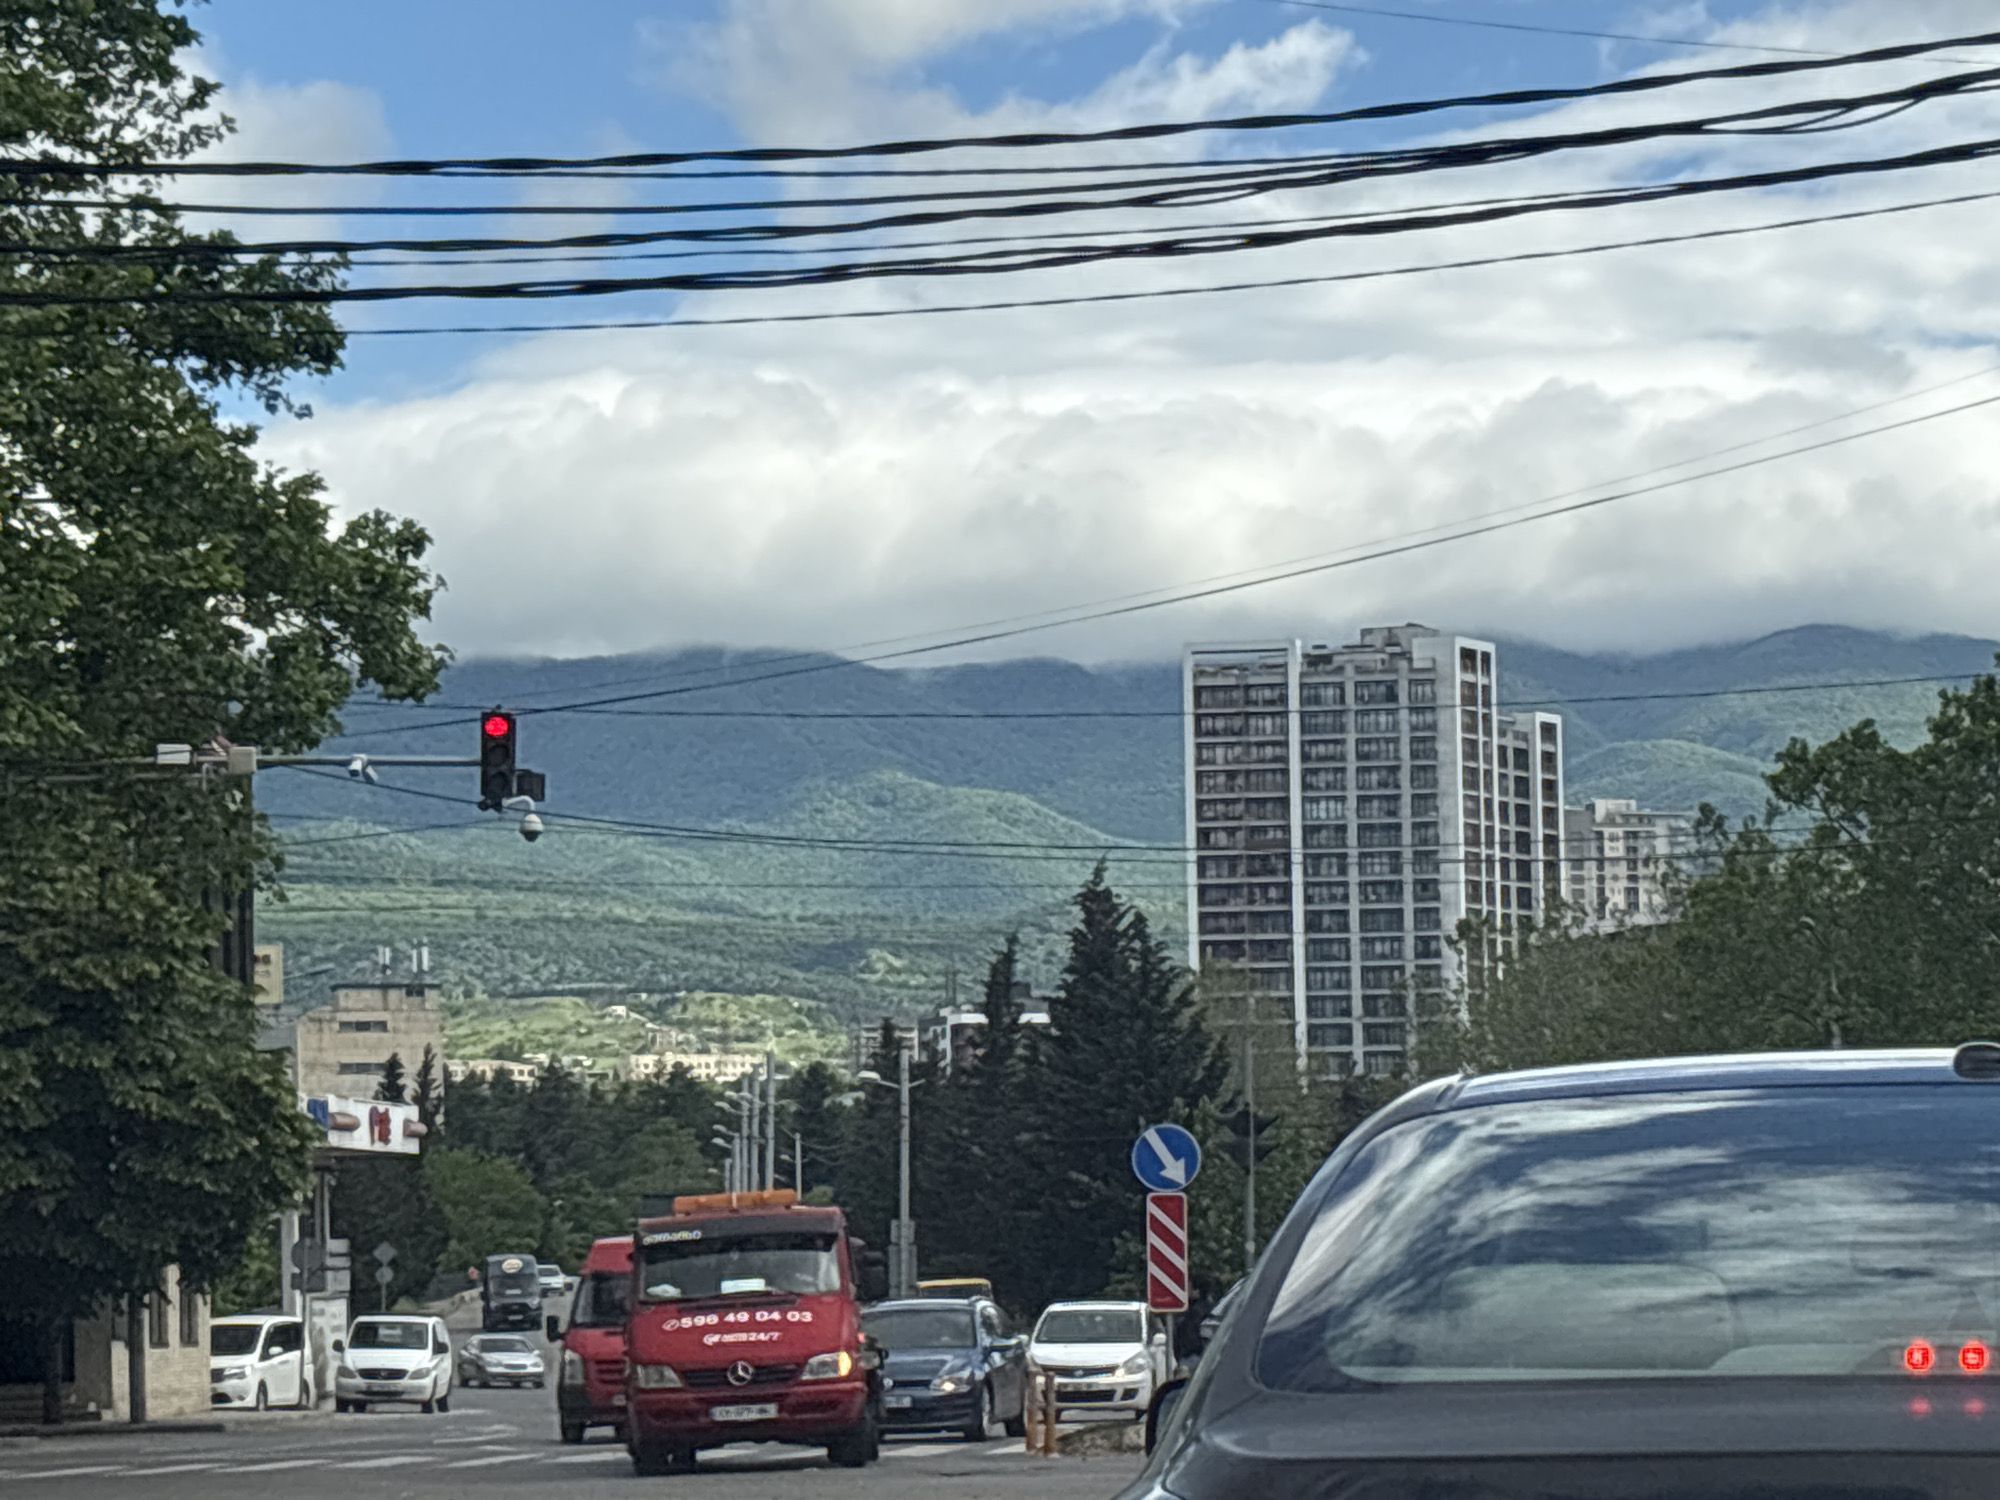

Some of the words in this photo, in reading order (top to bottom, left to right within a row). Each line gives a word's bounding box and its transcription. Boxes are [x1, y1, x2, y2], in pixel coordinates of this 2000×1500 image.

[723, 1312, 749, 1323] 49
[755, 1311, 781, 1322] 04
[786, 1311, 813, 1322] 03
